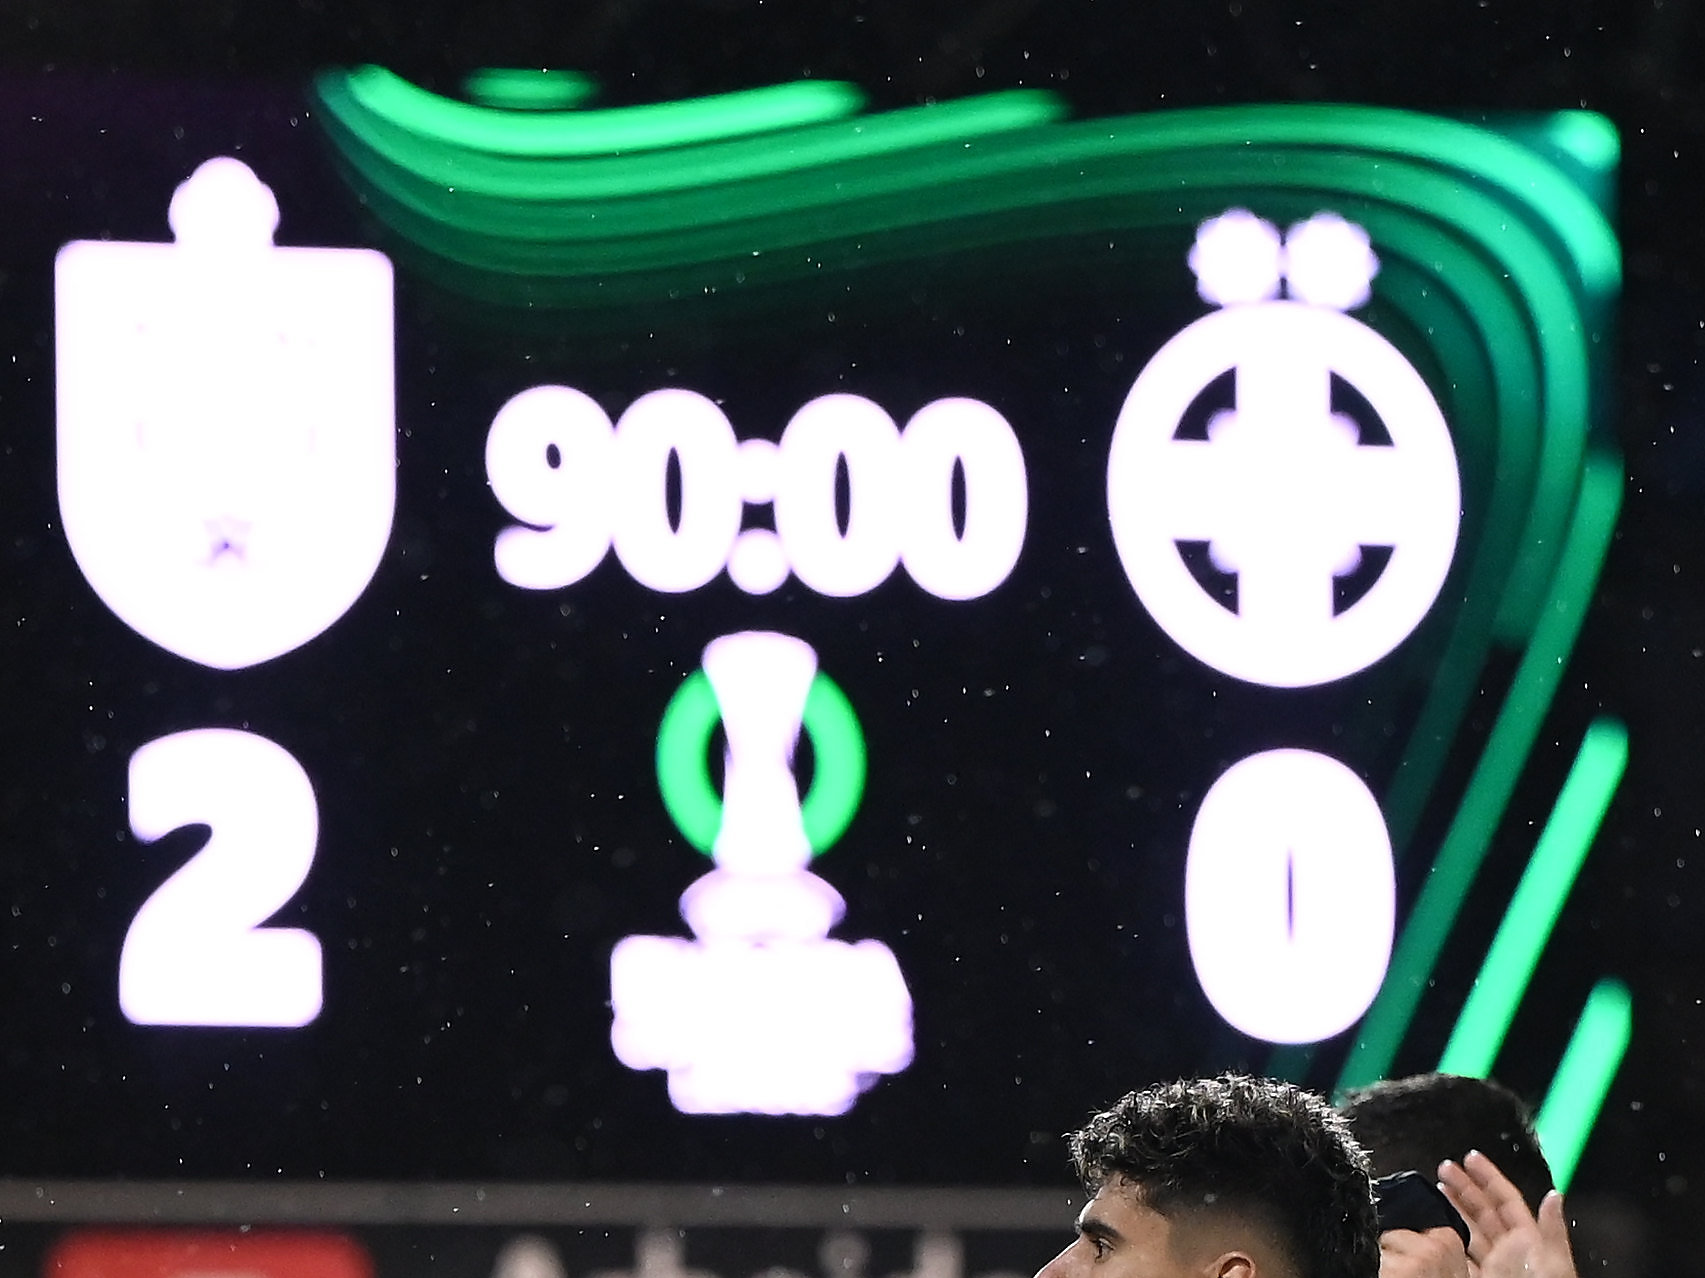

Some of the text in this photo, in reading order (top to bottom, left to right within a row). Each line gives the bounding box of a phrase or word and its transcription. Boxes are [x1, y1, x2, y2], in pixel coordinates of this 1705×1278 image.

[486, 384, 1029, 600] 90:00
[119, 728, 324, 1027] 2
[1186, 748, 1397, 1044] 0
